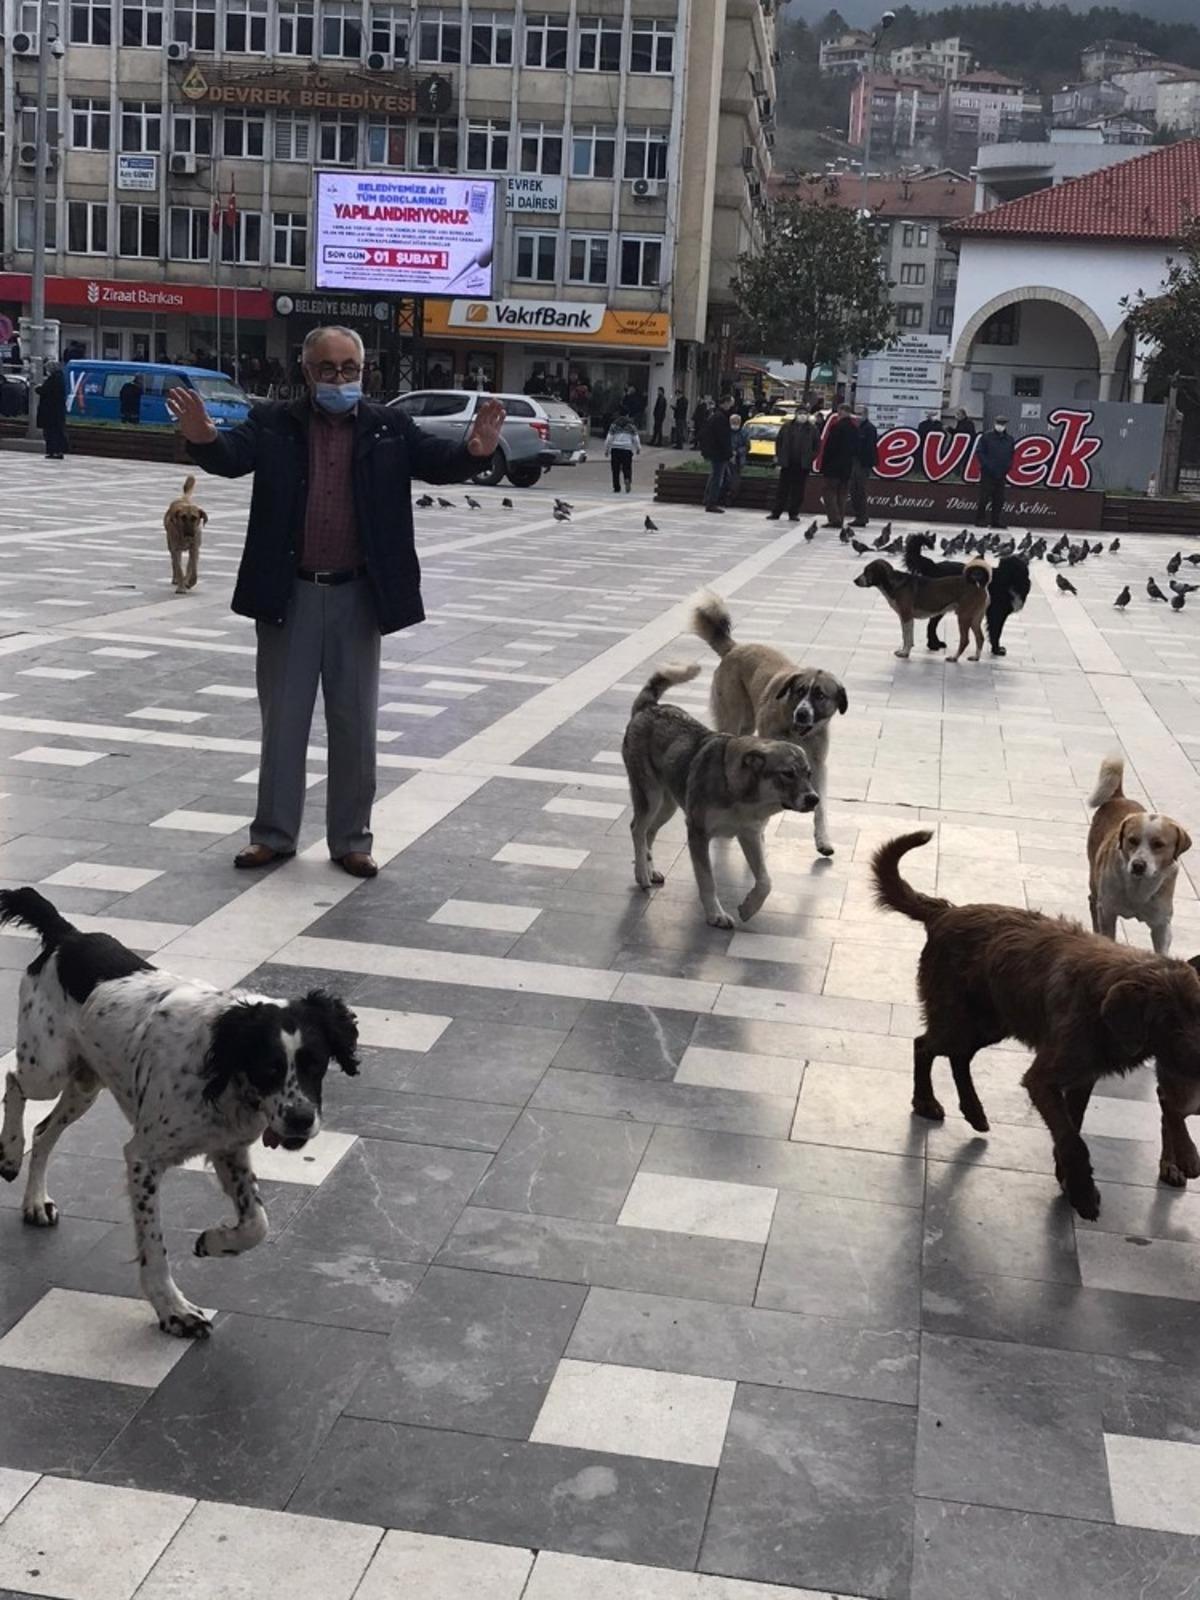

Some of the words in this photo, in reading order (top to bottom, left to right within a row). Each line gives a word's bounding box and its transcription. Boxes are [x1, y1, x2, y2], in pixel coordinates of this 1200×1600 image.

[209, 86, 290, 106] DEVREK
[299, 89, 416, 112] BELEDİYESİ
[358, 183, 427, 195] BELEDİYEMİZE
[428, 184, 446, 195] AİT
[508, 178, 543, 192] EVREK
[356, 192, 377, 203] TÜM
[518, 194, 558, 210] DAİRESİ
[334, 203, 470, 225] YAPILANDIRIYORUZ
[327, 250, 346, 259] SON
[347, 251, 366, 260] GÜN
[373, 250, 390, 264] 01
[396, 251, 439, 265] ŞUBAT
[102, 287, 137, 302] Ziraat
[139, 289, 184, 305] Bankası
[295, 298, 338, 315] BELEDİYE
